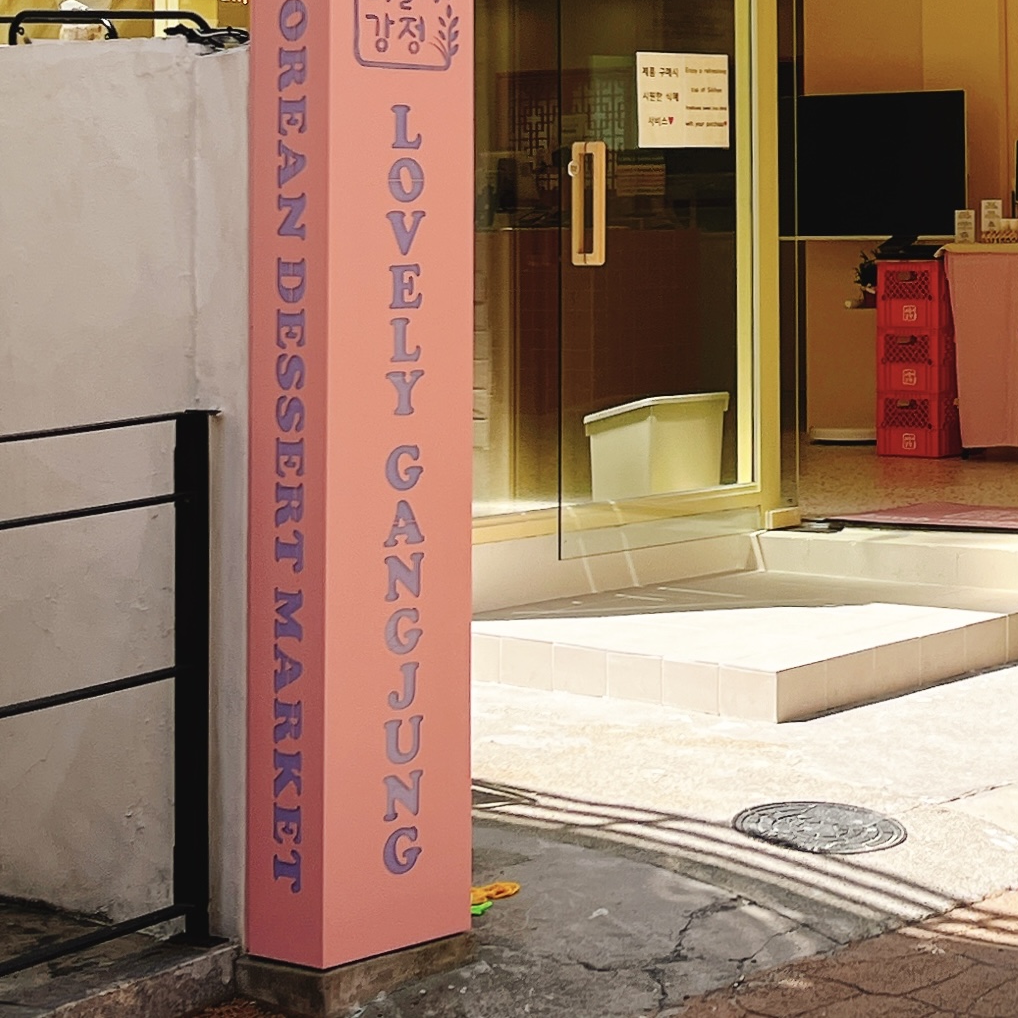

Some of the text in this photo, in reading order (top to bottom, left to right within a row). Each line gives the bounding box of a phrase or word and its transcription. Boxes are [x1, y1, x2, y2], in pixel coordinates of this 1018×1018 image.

[365, 13, 426, 55] 강정
[274, 257, 306, 574] DESSERT
[383, 104, 426, 875] LOVELY GANGJUNG
[272, 588, 304, 893] MARKET
